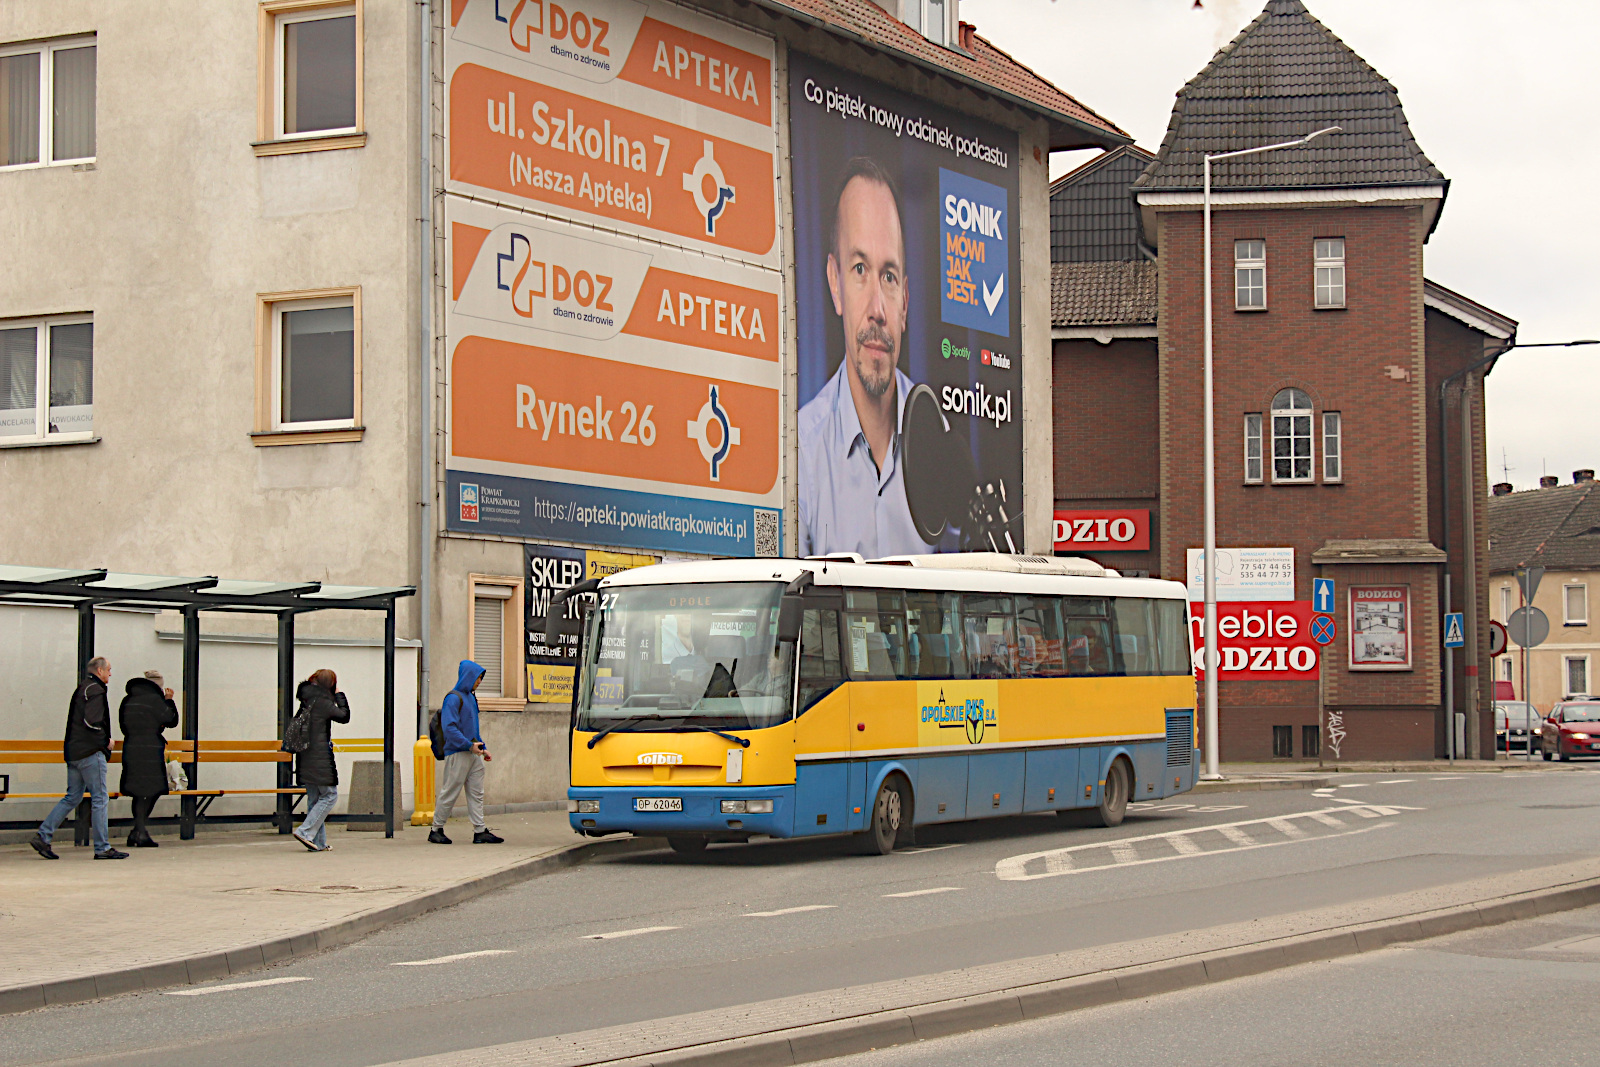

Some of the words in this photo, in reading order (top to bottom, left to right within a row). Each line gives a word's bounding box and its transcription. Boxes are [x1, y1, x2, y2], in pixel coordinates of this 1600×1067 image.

[550, 4, 610, 57] DOZ
[550, 44, 573, 60] dbam
[573, 53, 579, 61] o
[580, 52, 610, 71] zdrowie
[652, 40, 760, 106] APTEKA
[487, 92, 525, 140] ul.
[532, 100, 647, 173] Szkolna
[653, 134, 670, 177] 7
[804, 78, 823, 104] Co
[826, 87, 867, 121] piątek
[869, 104, 904, 137] nowy
[906, 117, 953, 150] odcinek
[956, 135, 1008, 169] podcastu
[509, 152, 575, 196] (Nasza
[578, 172, 652, 220] Apteka)
[945, 194, 1002, 240] SONIK
[946, 231, 985, 263] MÓWI
[946, 256, 971, 282] JAK
[553, 264, 614, 312] DOZ
[946, 277, 978, 306] JEST.
[553, 306, 576, 320] dbam
[576, 312, 582, 320] o
[583, 311, 614, 327] zdrowie
[657, 288, 766, 343] APTEKA
[951, 344, 971, 361] Spotify
[991, 351, 1011, 370] YouTube
[516, 383, 614, 442] Rynek
[620, 401, 656, 447] 26
[942, 382, 1011, 428] sonik.pl
[534, 496, 748, 540] https://apteki.powiatkrapkowicki.pl
[531, 557, 582, 589] SKLEP
[600, 593, 620, 610] 27
[1357, 590, 1401, 599] BODZIO
[921, 706, 964, 722] OPOLSKIE
[965, 698, 985, 722] PKS
[638, 799, 651, 809] OP
[653, 799, 681, 810] 62046
